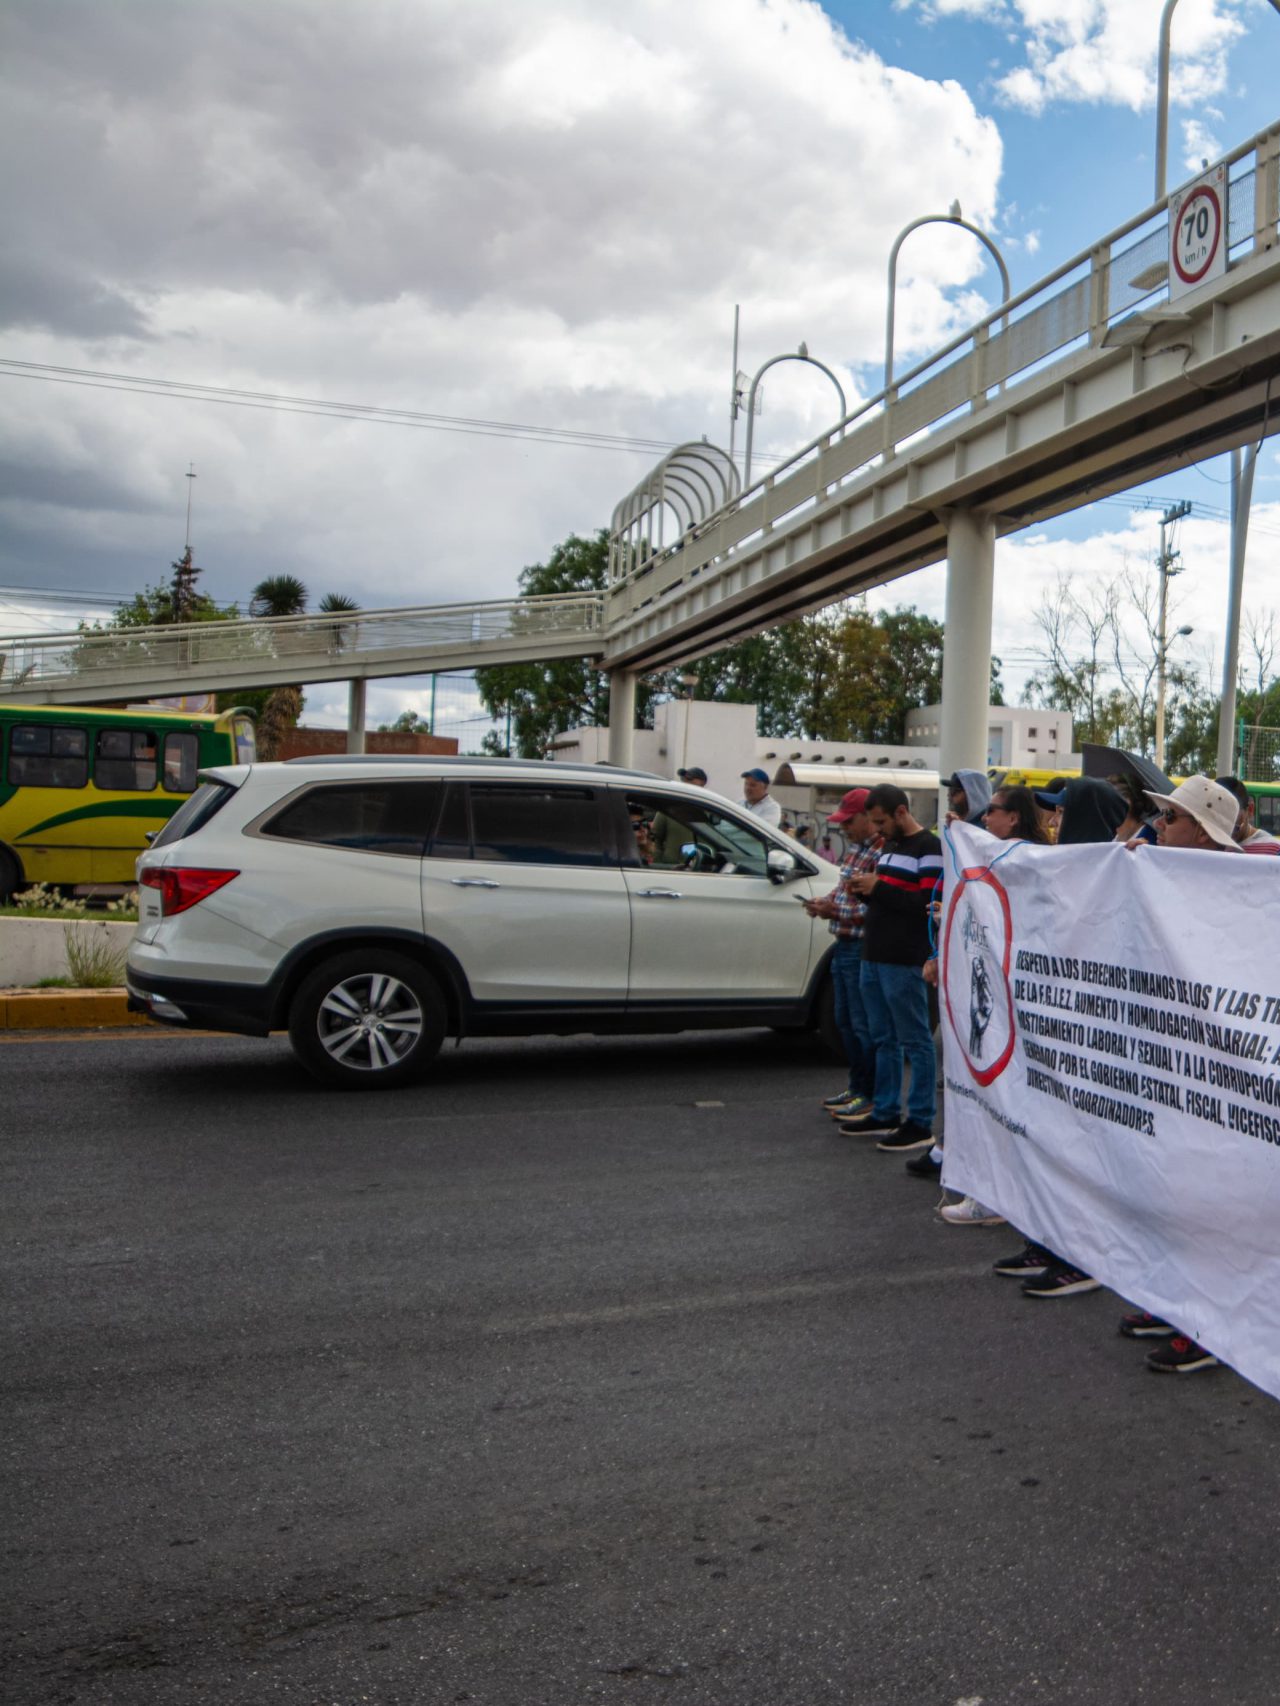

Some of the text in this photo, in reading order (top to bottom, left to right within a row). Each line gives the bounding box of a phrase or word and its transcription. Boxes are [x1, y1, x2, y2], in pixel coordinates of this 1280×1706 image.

[1184, 207, 1208, 246] 70
[1015, 950, 1050, 976] RESPETO
[1051, 956, 1060, 978] A
[1060, 957, 1079, 981] LOS
[1081, 960, 1127, 991] DERECHOS
[1129, 968, 1175, 1001] HUMANOS
[1176, 978, 1189, 1004] DE
[1188, 981, 1212, 1010] LOS
[1213, 986, 1228, 1013] Y
[1224, 989, 1261, 1020] LAS
[1014, 979, 1025, 1000] DE
[1026, 981, 1038, 1003] LA
[1074, 991, 1118, 1022] AUMENTO
[1120, 1001, 1126, 1024] Y
[1127, 1002, 1205, 1044] HOMOLOGACIÓN
[1206, 1022, 1272, 1065] SALARIAL;
[1086, 1026, 1128, 1059] LABORAL
[1130, 1037, 1136, 1060] Y
[1137, 1039, 1173, 1073] SEXUAL
[1175, 1049, 1182, 1075] Y
[1183, 1052, 1192, 1078] A
[1193, 1054, 1206, 1082] LA
[1058, 1051, 1078, 1077] POR
[1079, 1057, 1089, 1080] EL
[1090, 1060, 1138, 1096] GOBIERNO
[1140, 1075, 1184, 1114] ESTATAL,
[1186, 1088, 1226, 1129] FISCAL,
[1072, 1086, 1156, 1138] COORDINADORES.
